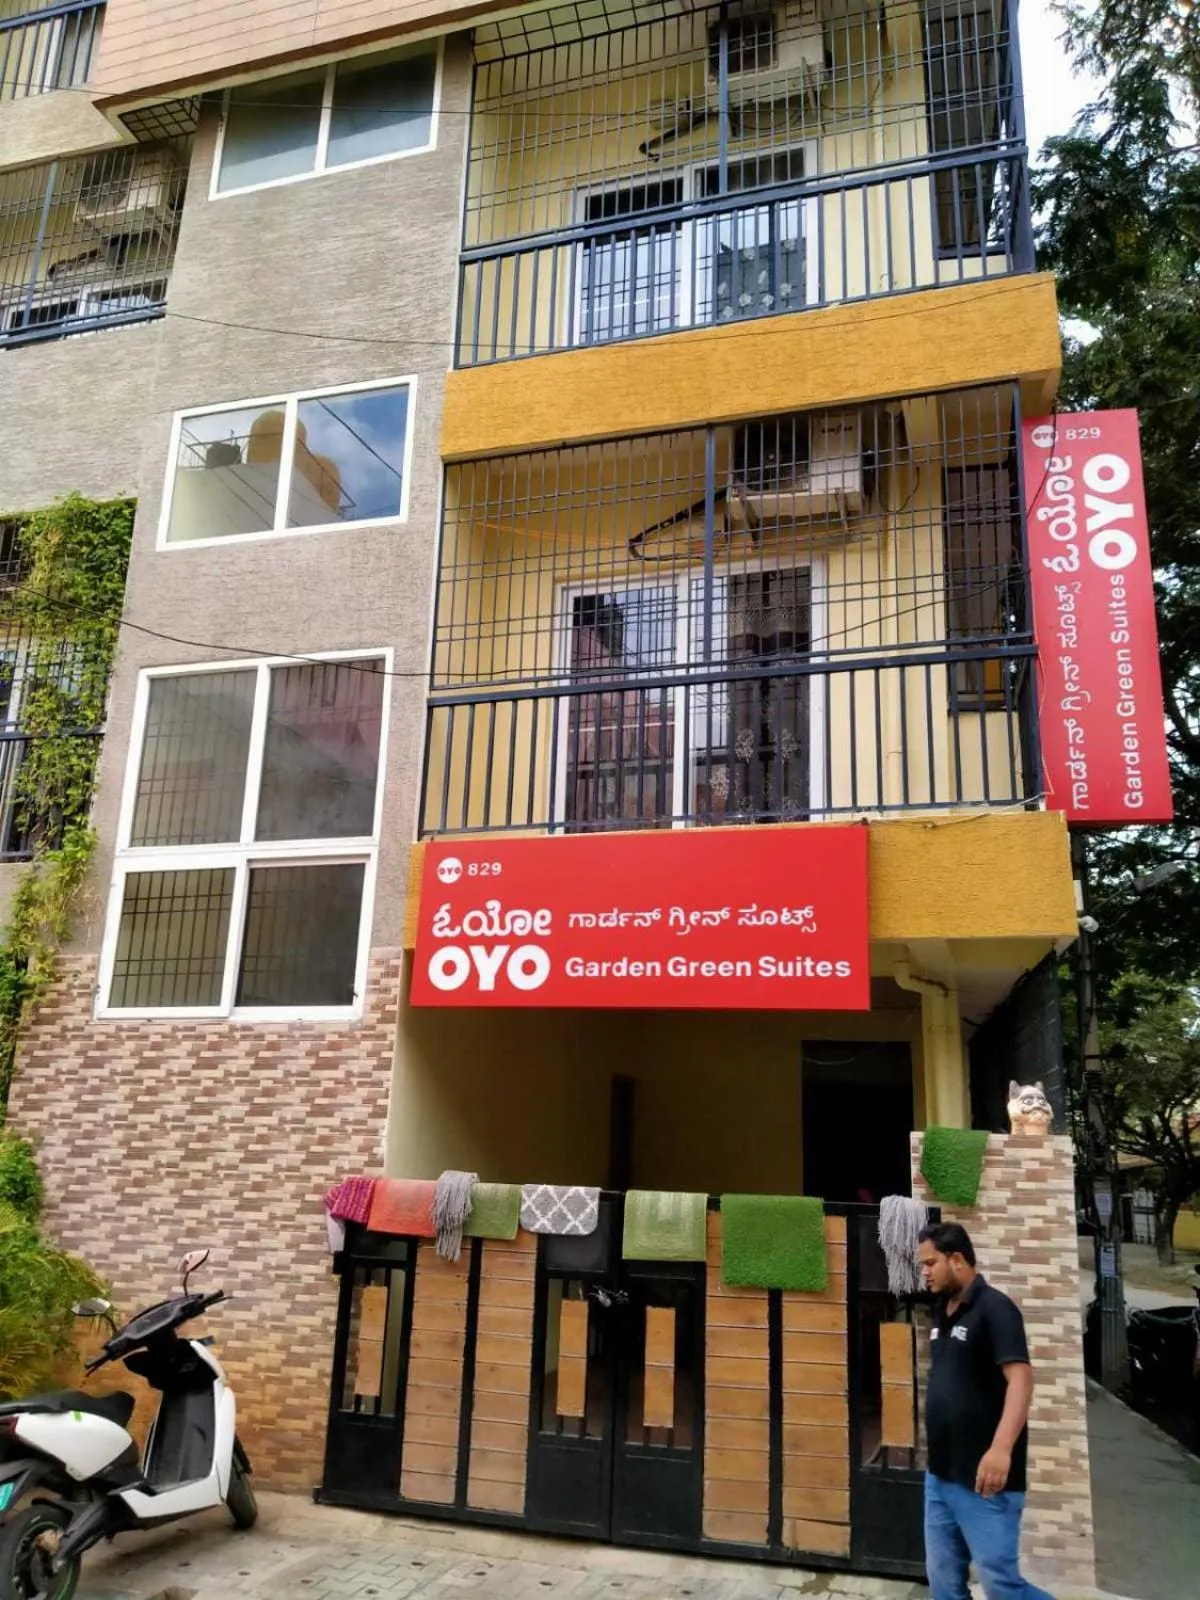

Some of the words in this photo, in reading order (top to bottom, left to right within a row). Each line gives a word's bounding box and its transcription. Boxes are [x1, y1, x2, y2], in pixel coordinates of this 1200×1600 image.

[1065, 427, 1101, 441] 829
[1082, 453, 1138, 570] OYO
[1110, 574, 1131, 644] Suites
[1059, 656, 1091, 711] ಗ್ರೀನ್
[1116, 649, 1136, 717] Green
[1120, 722, 1144, 809] Garden
[467, 861, 503, 877] 829
[668, 905, 731, 936] ಗ್ರೀನ್
[428, 944, 551, 991] OYO
[564, 957, 662, 978] Garden
[667, 957, 752, 978] Green
[758, 955, 852, 977] Suites
